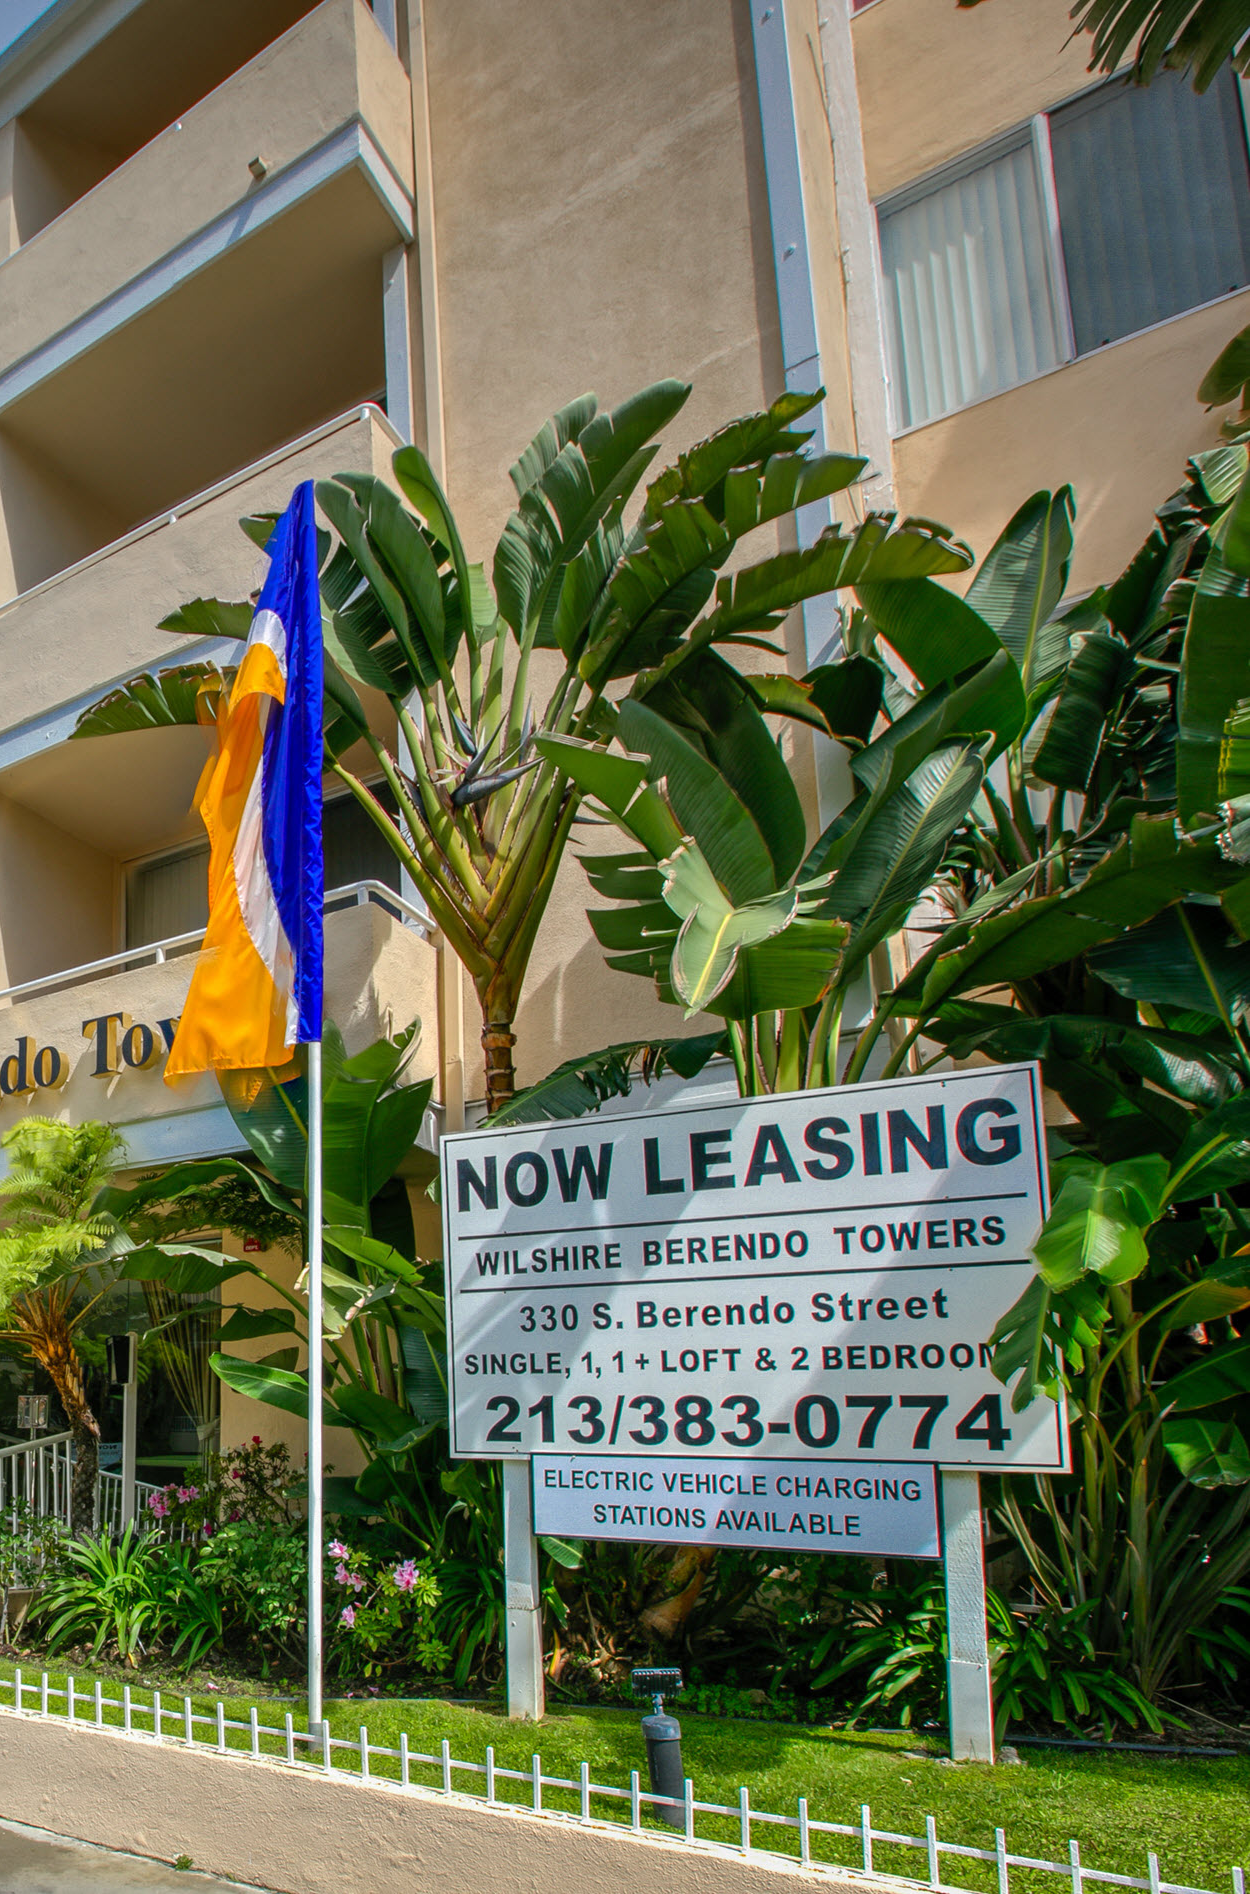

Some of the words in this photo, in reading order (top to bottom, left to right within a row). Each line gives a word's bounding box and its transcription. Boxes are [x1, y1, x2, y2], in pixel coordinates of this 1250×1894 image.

[456, 1142, 614, 1213] NOW
[643, 1097, 1022, 1196] LEASING
[475, 1242, 623, 1278] WILSHIRE
[642, 1230, 809, 1267] BERENDO
[833, 1215, 1006, 1255] TOWERS
[519, 1304, 579, 1333] 330
[592, 1302, 623, 1330] S.
[636, 1295, 795, 1328] Berendo
[811, 1288, 949, 1324] Street
[464, 1352, 571, 1379] SINGLE,
[581, 1351, 601, 1379] 1,
[612, 1350, 624, 1373] 1
[661, 1347, 741, 1373] LOFT
[755, 1347, 777, 1372] &
[791, 1345, 810, 1371] 2
[485, 1393, 1012, 1452] 213/383-0774
[544, 1469, 654, 1493] ELECTRIC
[662, 1472, 768, 1496] VEHICLE
[775, 1476, 922, 1502] CHARGING
[593, 1504, 706, 1529] STATIONS
[715, 1509, 862, 1537] AVAILABLE
